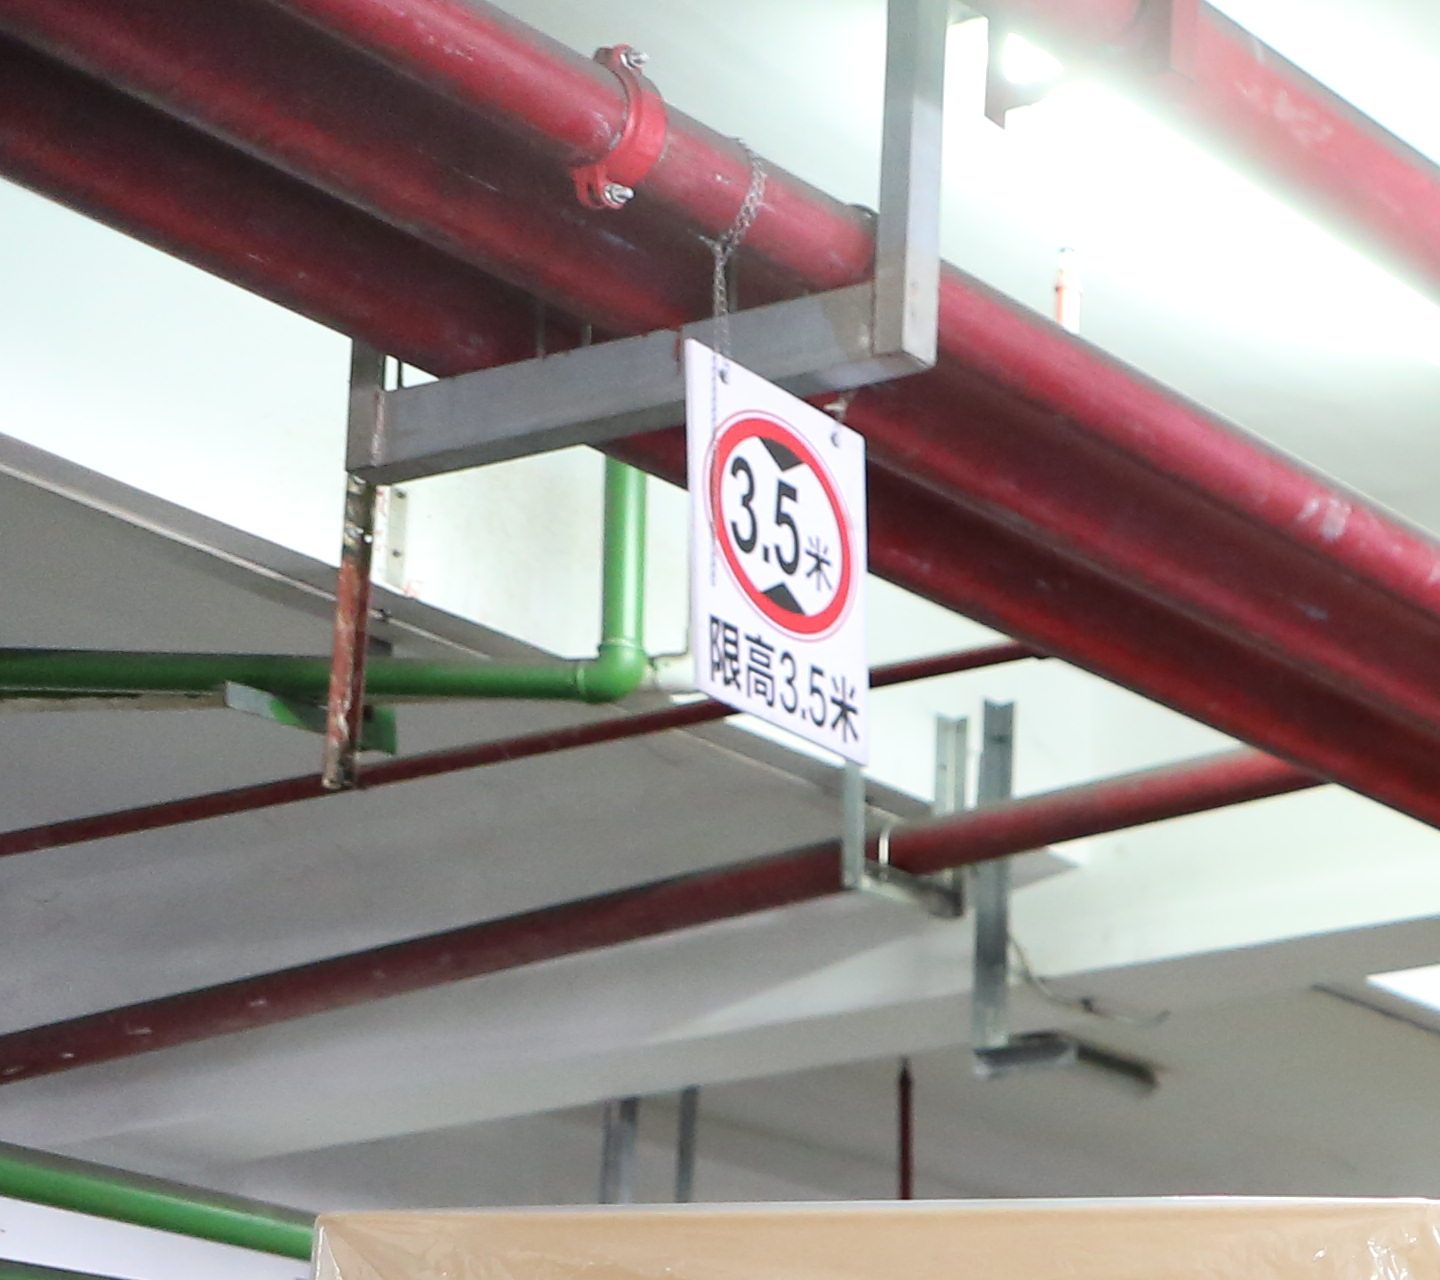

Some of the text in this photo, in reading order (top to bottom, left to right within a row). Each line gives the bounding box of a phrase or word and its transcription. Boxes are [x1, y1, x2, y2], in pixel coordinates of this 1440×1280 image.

[731, 456, 833, 592] 3.5米
[708, 614, 860, 744] 限高3.5米
